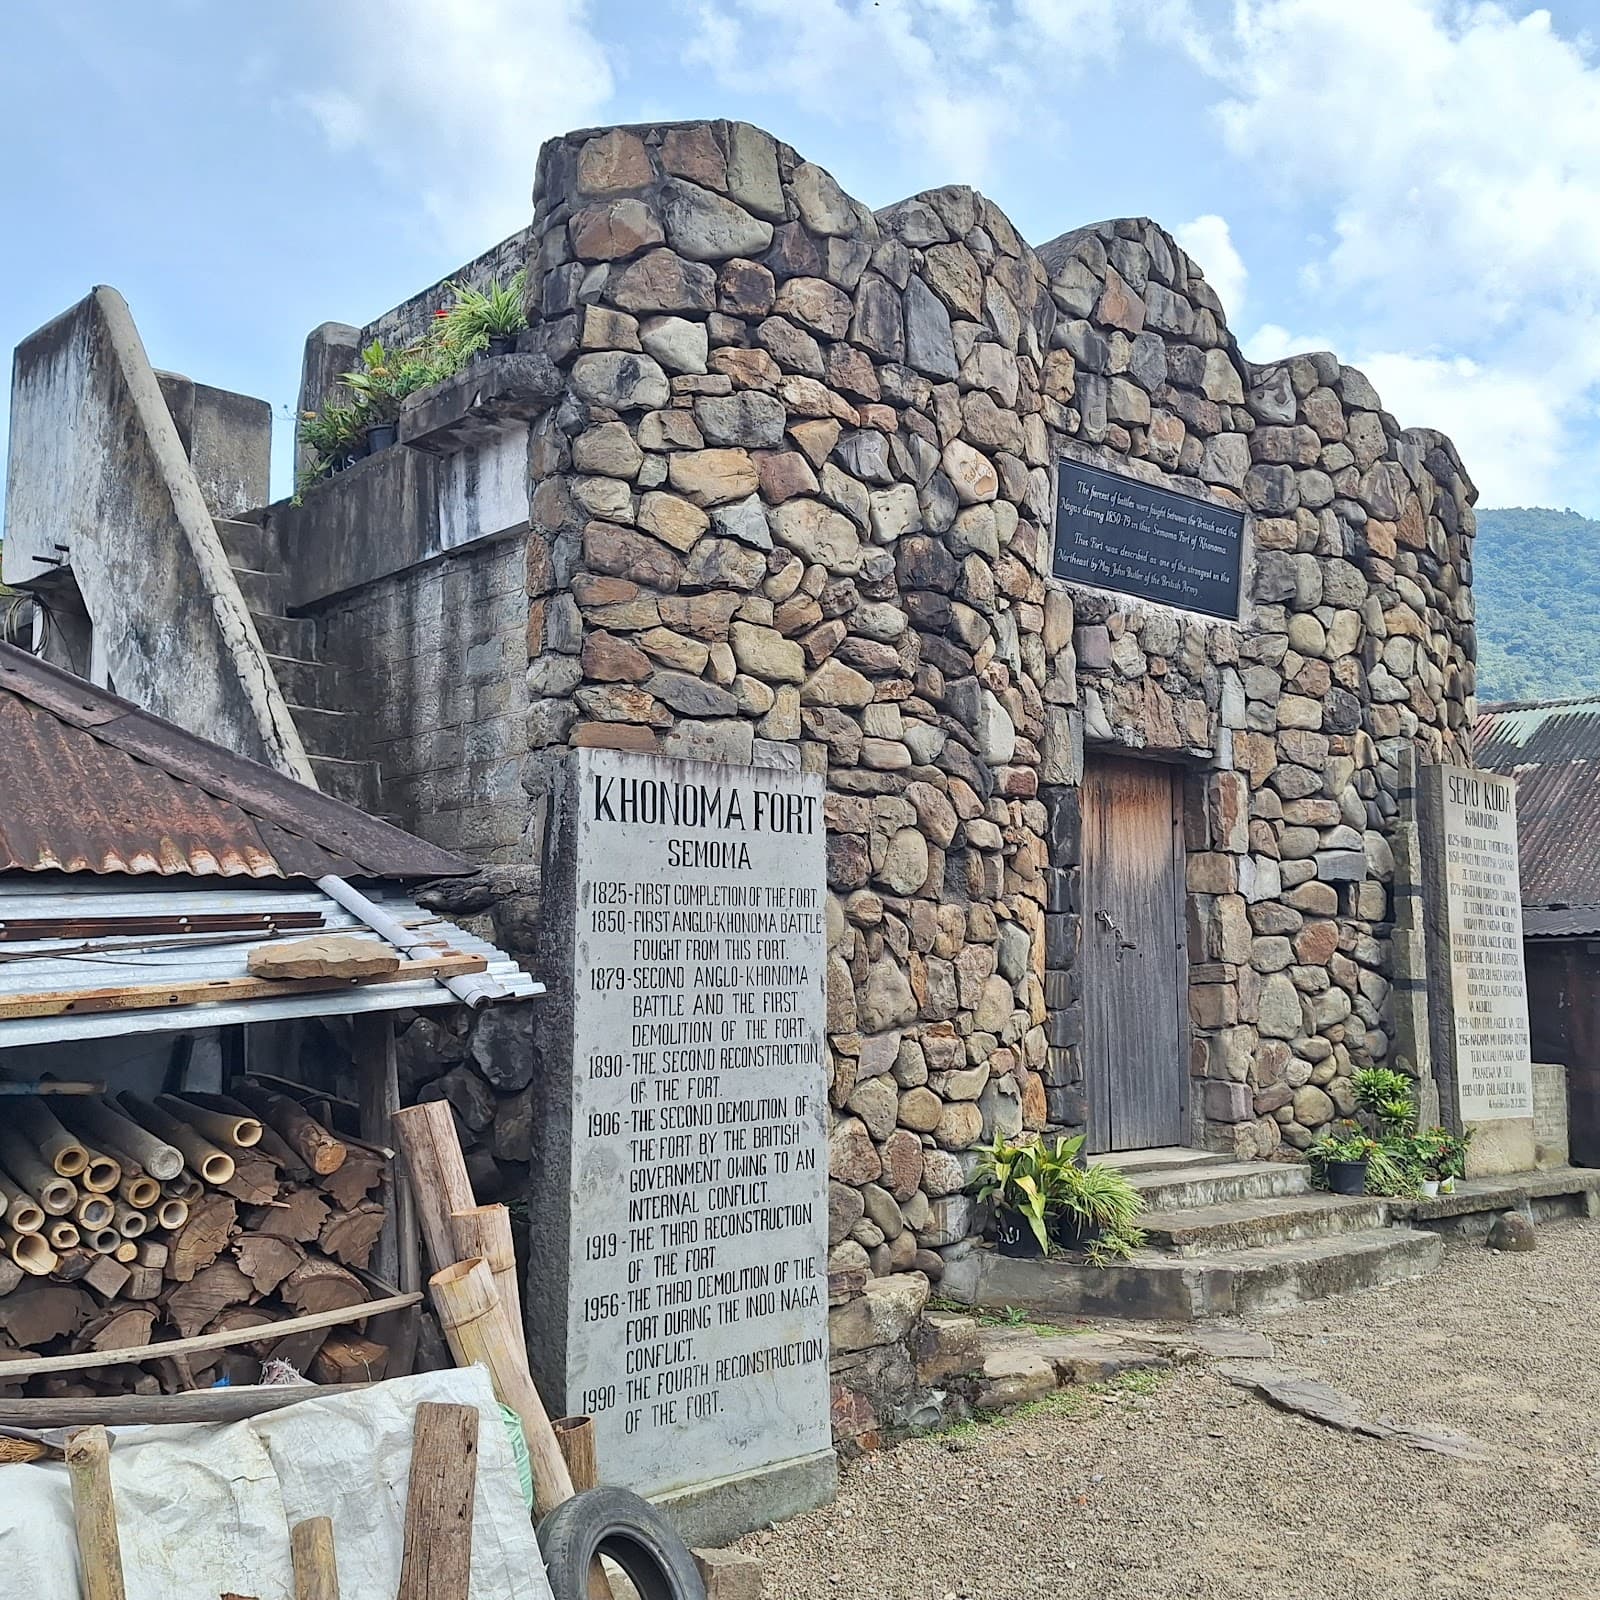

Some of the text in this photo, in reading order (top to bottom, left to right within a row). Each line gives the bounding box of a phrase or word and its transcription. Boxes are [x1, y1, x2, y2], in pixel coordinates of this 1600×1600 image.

[1060, 497, 1081, 516] Nagas
[1082, 504, 1104, 524] during
[1131, 522, 1138, 530] in
[1139, 520, 1150, 534] this
[1152, 524, 1177, 540] Semoma
[1178, 530, 1190, 544] Fort
[1191, 536, 1198, 550] of
[1199, 536, 1226, 554] Khonoma
[1078, 481, 1090, 496] The
[1110, 492, 1118, 506] of
[1117, 493, 1135, 508] battles
[1136, 504, 1149, 512] were
[1147, 503, 1166, 520] fought
[1166, 508, 1187, 524] between
[1188, 514, 1196, 526] the
[1196, 516, 1215, 532] British
[1216, 525, 1227, 536] and
[1228, 527, 1237, 539] the
[1057, 548, 1089, 567] Northeast
[1090, 557, 1098, 571] by
[1110, 562, 1126, 577] John
[1126, 566, 1143, 580] Butler
[1144, 572, 1150, 585] of
[1151, 573, 1160, 584] the
[1161, 574, 1180, 590] British
[1180, 580, 1198, 596] Army
[1074, 532, 1230, 583] This Fort was described as one of the strongest in the
[594, 775, 816, 834] KHONOMA FORT
[1448, 776, 1511, 815] SEMO KUDA
[668, 839, 752, 870] SEMOMA
[674, 884, 748, 908] COMPLETION
[749, 887, 762, 908] OF
[765, 887, 786, 908] THE
[789, 887, 819, 909] FORT.
[673, 911, 776, 934] ANGLO-KHONOMA
[780, 913, 822, 934] BATTLE
[633, 939, 789, 962] FOUGHT FROM THIS FORT.
[693, 965, 809, 988] ANGLO-KHONOMA
[633, 991, 798, 1018] BATTLE AND THE FIRST
[632, 1018, 809, 1047] DEMOLITION OF THE FORT.
[662, 1048, 715, 1073] SECOND
[720, 1043, 818, 1069] RECONSTRUCTION
[631, 1076, 723, 1104] OF THE FORT.
[660, 1103, 712, 1129] SECOND
[717, 1098, 787, 1124] DEMOLITION
[795, 1096, 809, 1116] OF
[630, 1124, 800, 1163] THE FORT BY THE BRITISH
[630, 1148, 815, 1193] GOVERNMENT OWING TO AN
[628, 1181, 771, 1222] INTERNAL CONFLICT.
[660, 1219, 698, 1246] THIRD
[704, 1203, 812, 1241] RECONSTRUCTION
[628, 1259, 643, 1283] OF
[654, 1253, 677, 1278] THE
[657, 1280, 692, 1308] THIRD
[698, 1265, 768, 1299] DEMOLITION
[774, 1261, 789, 1284] OF
[794, 1257, 816, 1280] THE
[626, 1285, 819, 1345] FORT DURING THE INDO NAGA
[626, 1338, 696, 1375] CONFLICT.
[657, 1363, 709, 1396] FOURTH
[715, 1338, 823, 1383] RECONSTRUCTION
[625, 1390, 724, 1434] OF THE FORT.
